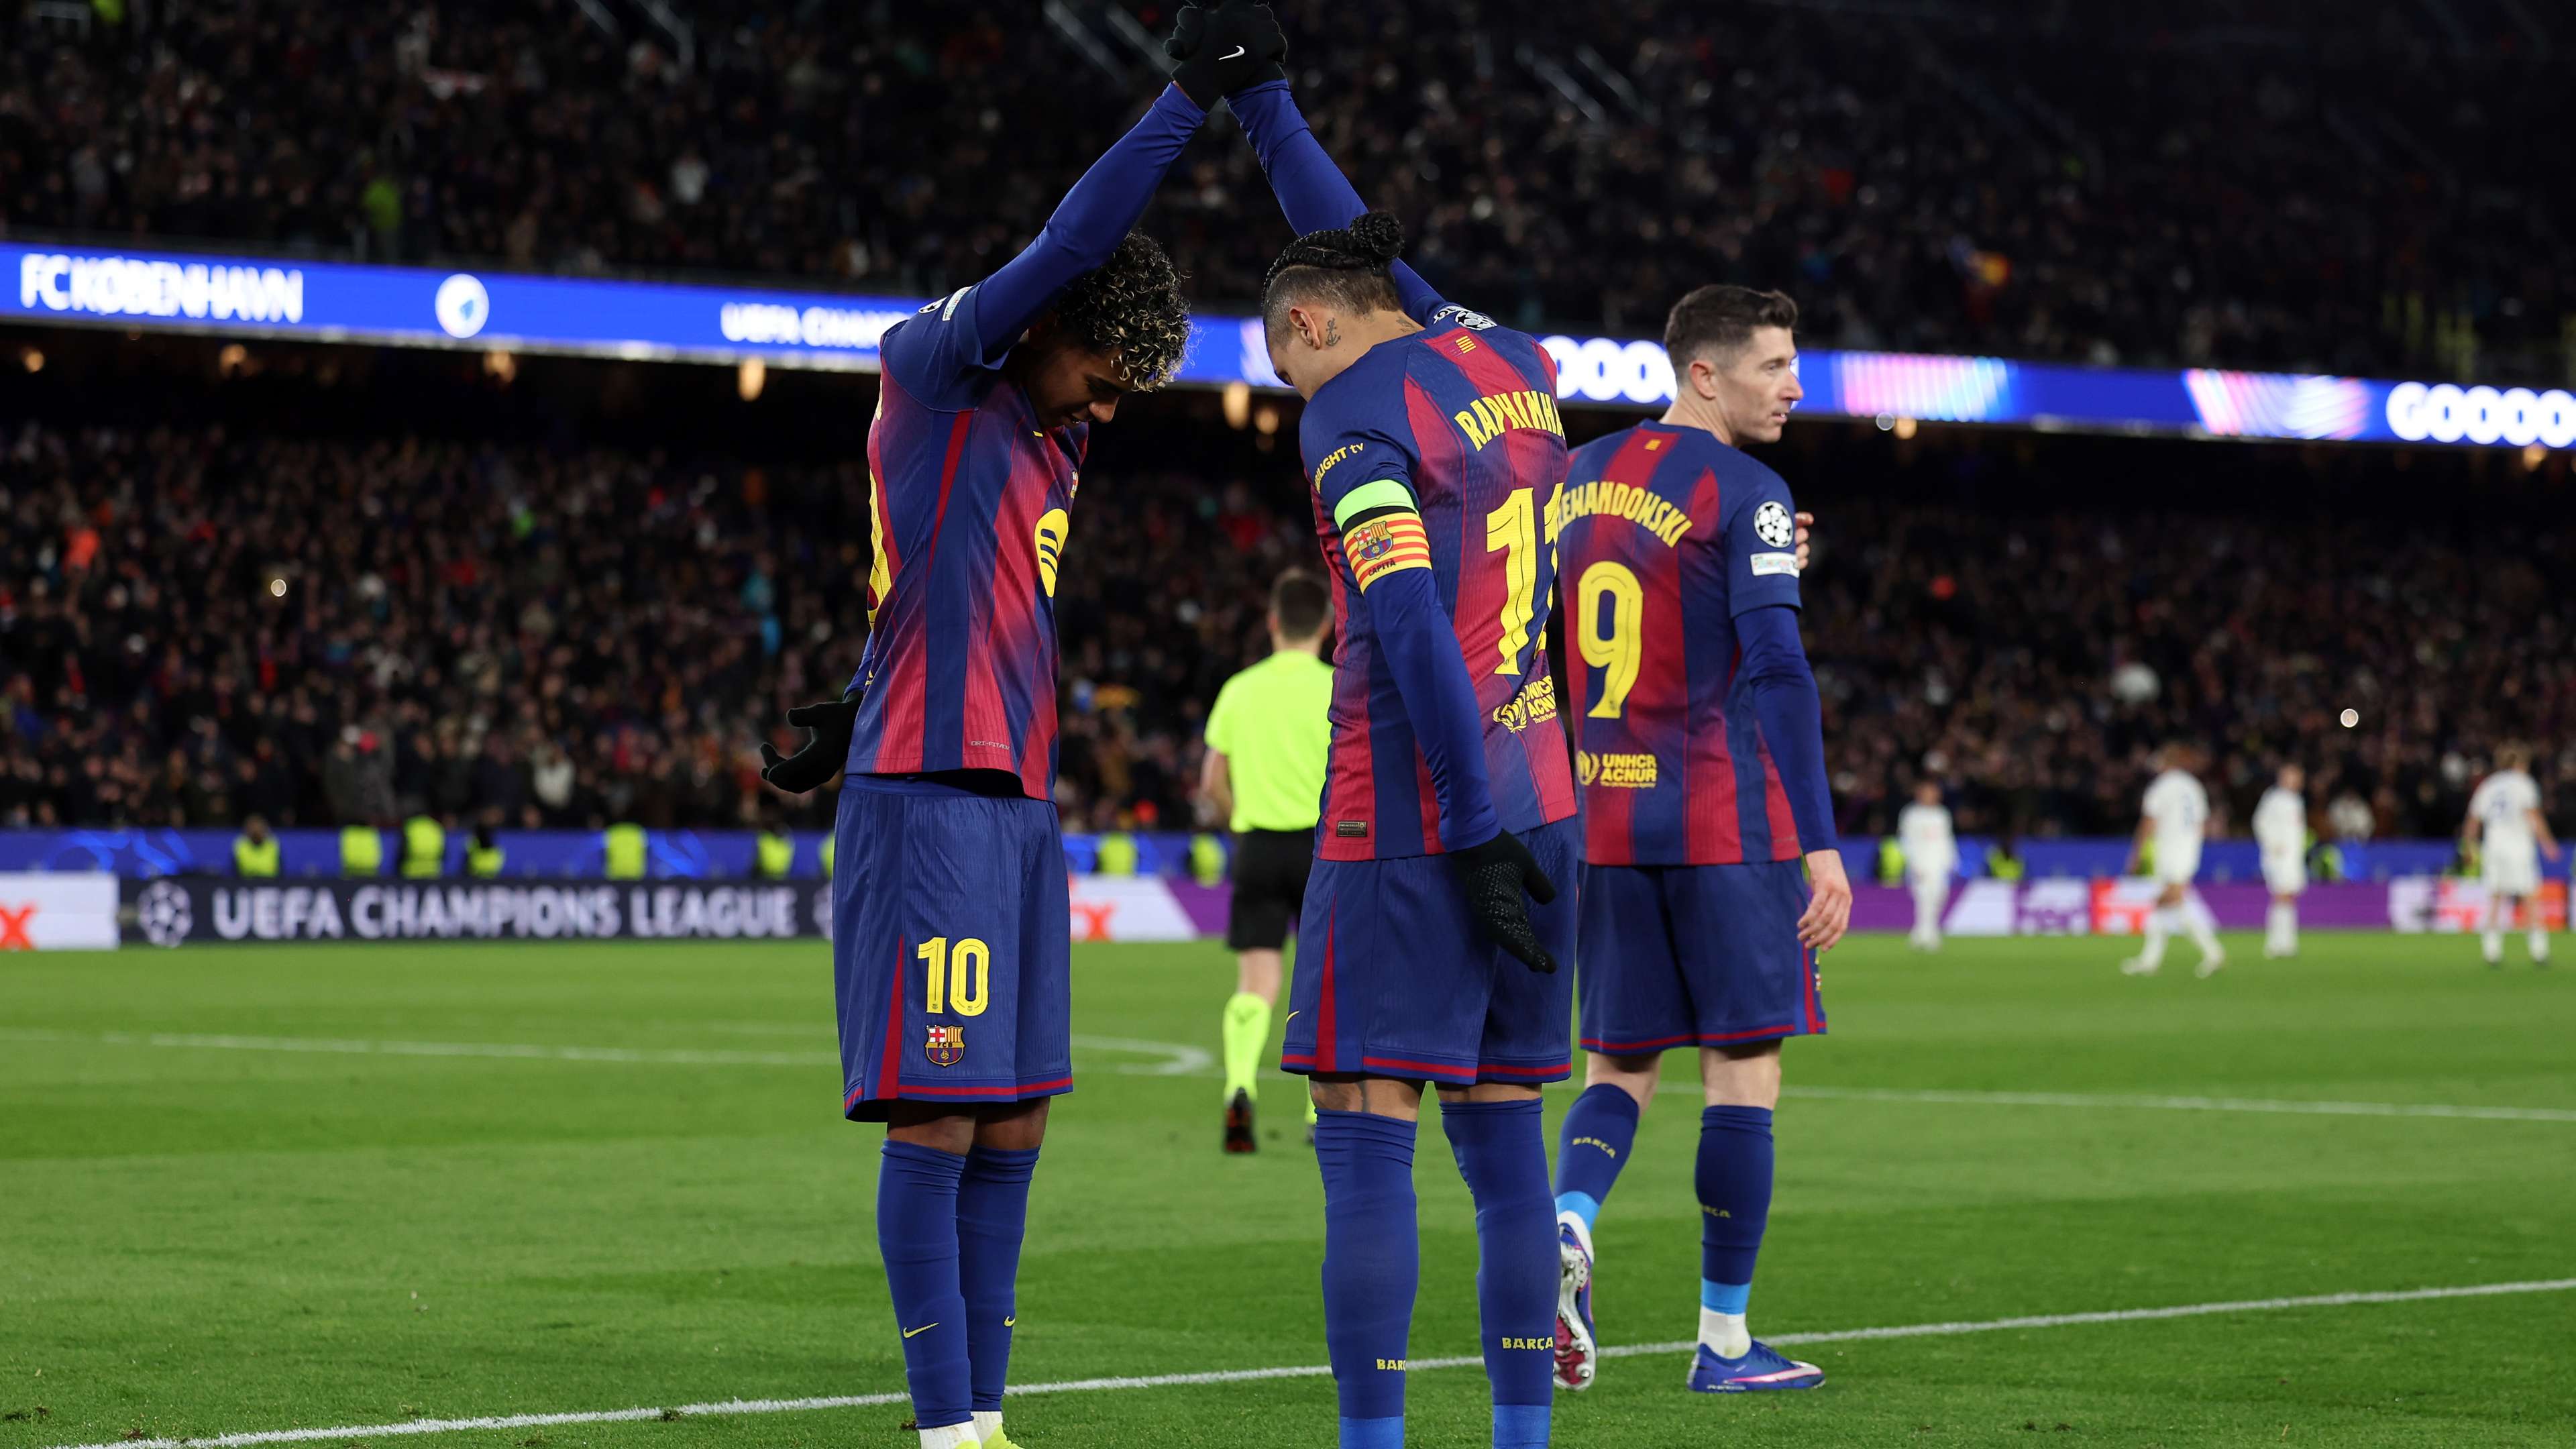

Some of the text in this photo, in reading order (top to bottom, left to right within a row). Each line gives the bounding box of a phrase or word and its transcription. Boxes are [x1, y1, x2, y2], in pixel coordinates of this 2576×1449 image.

[20, 252, 71, 311] FC
[720, 302, 802, 345] UEFA
[1349, 443, 1364, 453] tv
[1578, 561, 1643, 718] 9
[1526, 694, 1556, 718] ACN
[1599, 767, 1658, 782] ACNUR
[1602, 753, 1657, 769] UNHCR
[212, 885, 798, 939] UEFA CHAMPIONS LEAGUE
[918, 937, 989, 1016] 10
[1502, 1337, 1554, 1351] BARÇA
